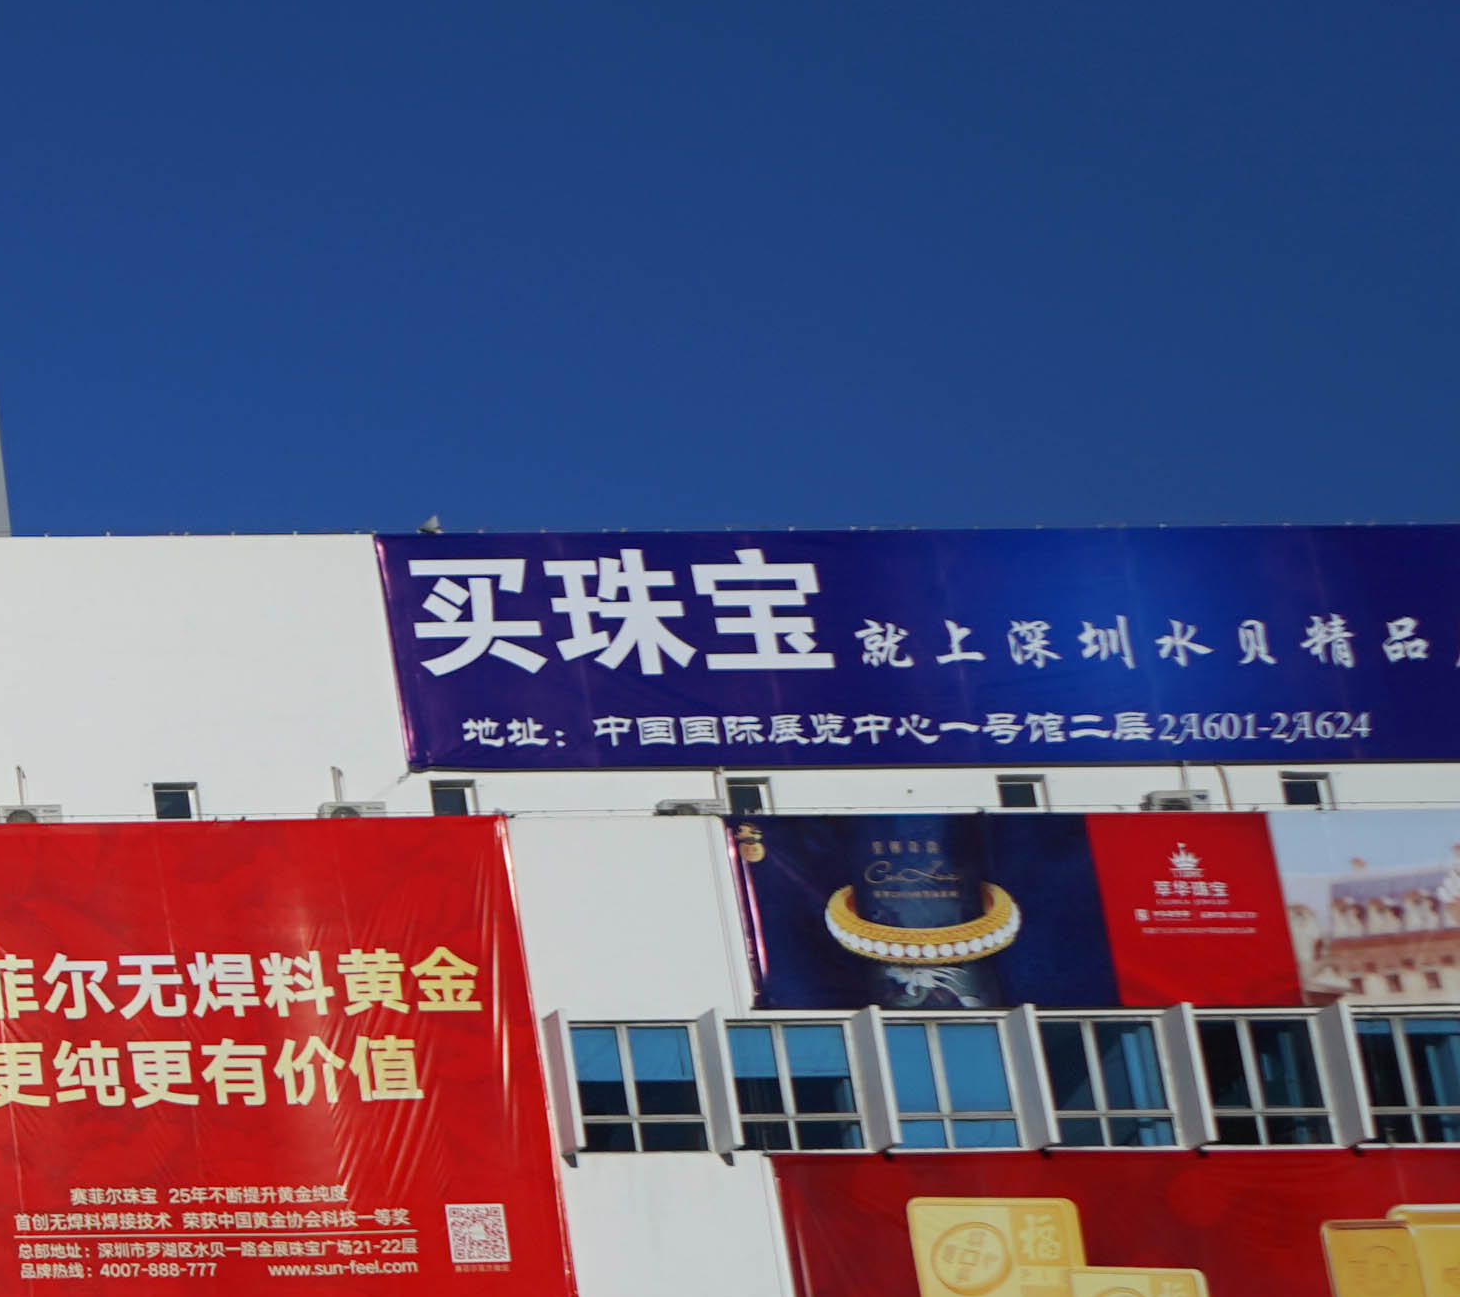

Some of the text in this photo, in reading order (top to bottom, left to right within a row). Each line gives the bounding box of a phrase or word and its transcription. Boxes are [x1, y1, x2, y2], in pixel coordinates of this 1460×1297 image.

[409, 549, 836, 677] 买珠宝
[855, 613, 1460, 672] 就上深圳水贝精品
[70, 1184, 349, 1205] 赛菲尔珠宝 25年不断提升黄金纯度
[15, 1208, 411, 1232] 首创无焊料焊接技术 荣获中国黄金协会科技一等奖
[268, 1260, 418, 1278] www.sun-feel.com
